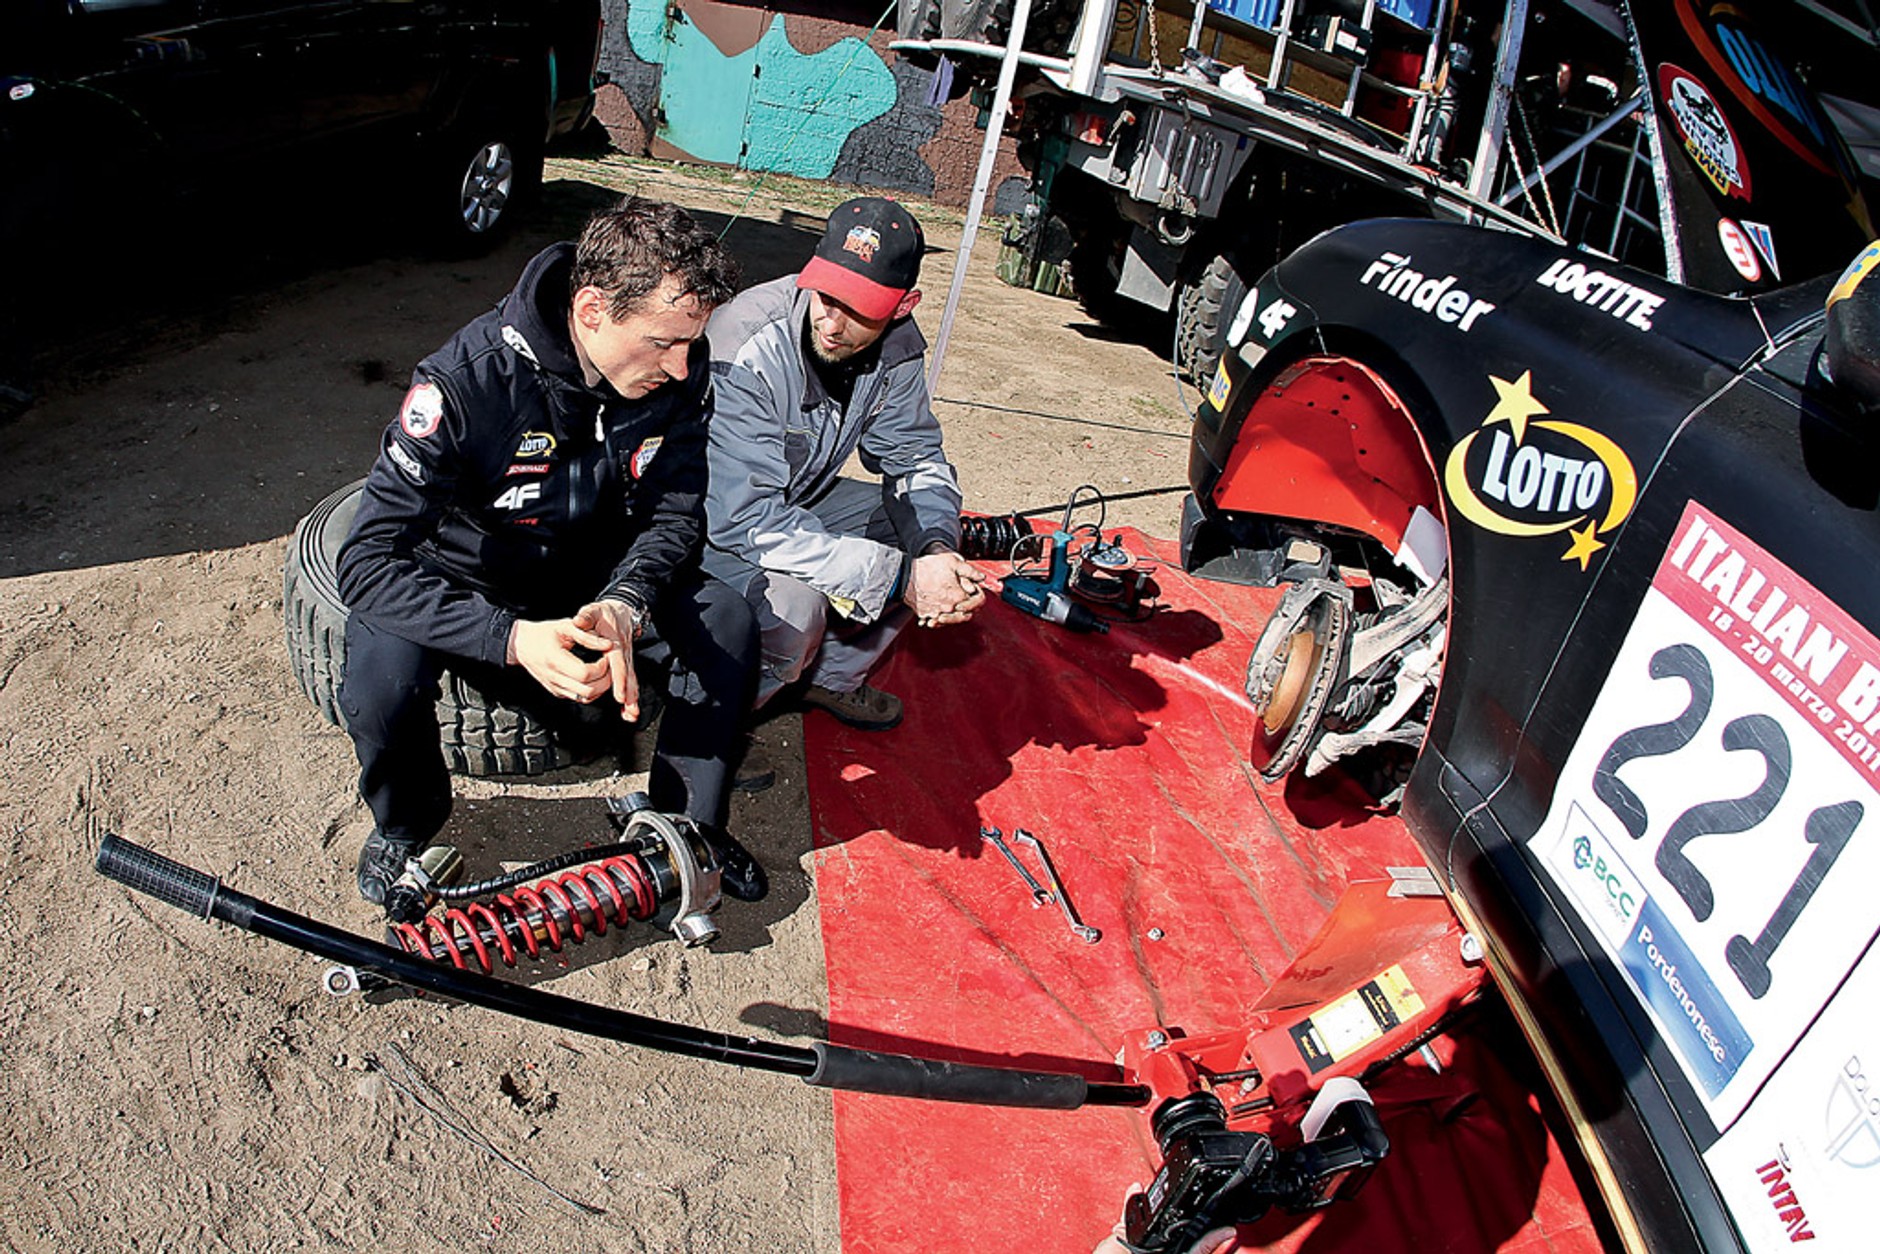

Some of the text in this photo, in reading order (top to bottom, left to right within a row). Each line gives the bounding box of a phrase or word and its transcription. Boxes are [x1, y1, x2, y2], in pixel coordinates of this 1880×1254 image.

[1690, 145, 1726, 189] RMF
[1258, 298, 1297, 339] 4F
[1360, 252, 1496, 332] Finder
[1536, 258, 1666, 332] LOCTITE
[519, 437, 549, 452] LOTTO
[1482, 429, 1605, 512] LOTTO
[493, 482, 541, 510] 4F
[1670, 514, 1849, 687] ITALIAN
[1707, 605, 1735, 633] 18
[1741, 639, 1774, 666] 20
[1769, 662, 1838, 724] marzo
[1834, 719, 1880, 773] 2011
[1592, 643, 1865, 999] 221
[1593, 855, 1635, 917] BCC
[1638, 924, 1727, 1064] Pordenonese
[1844, 1054, 1880, 1117] DOLO
[1755, 1159, 1816, 1243] INTAV
